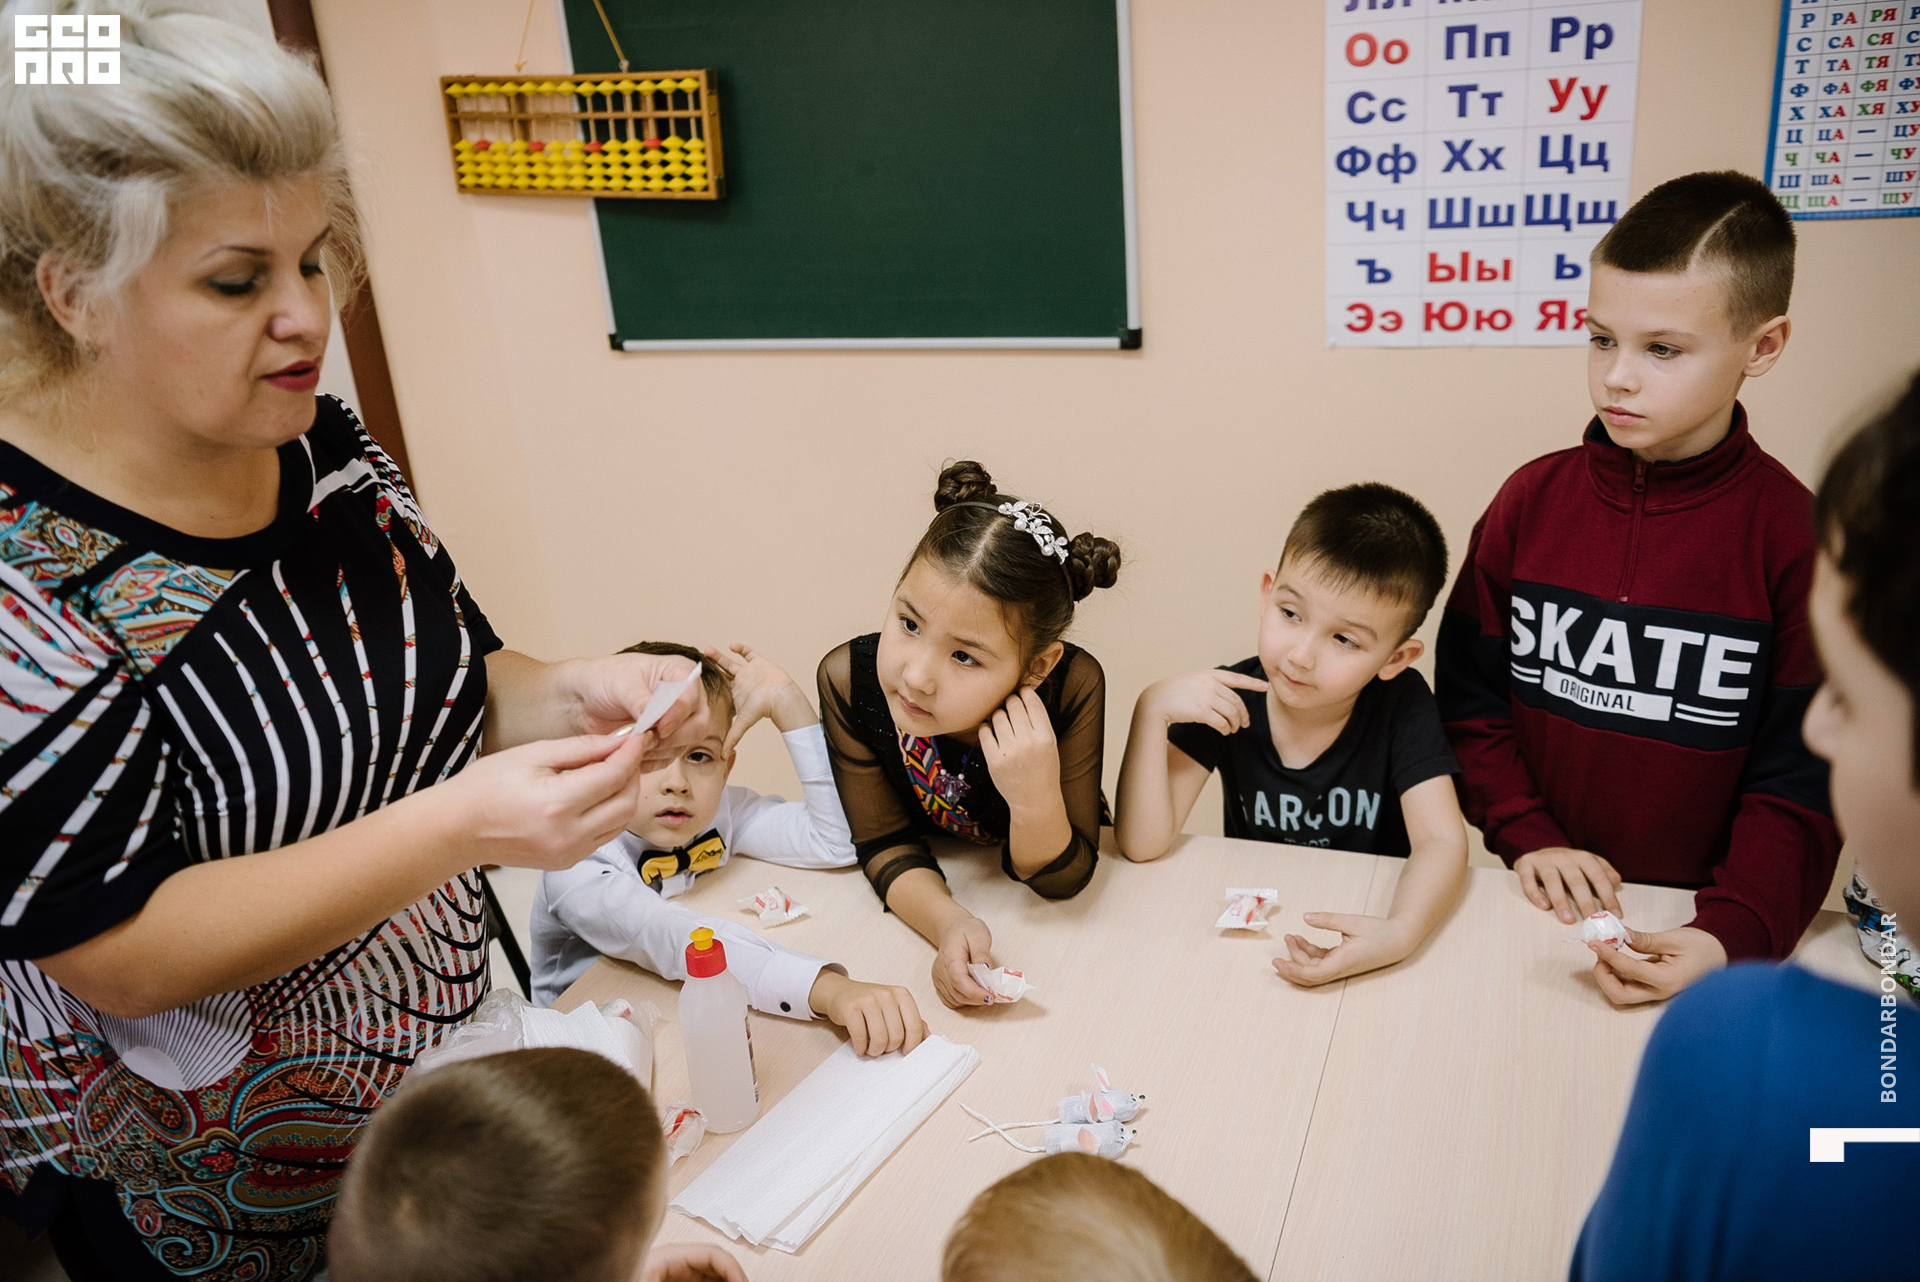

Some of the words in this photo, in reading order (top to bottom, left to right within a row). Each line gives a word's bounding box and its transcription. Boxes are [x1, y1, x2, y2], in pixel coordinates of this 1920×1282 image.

[1801, 13, 1816, 28] Р
[1831, 12, 1858, 26] РА
[1870, 8, 1898, 22] РЯ
[1345, 32, 1409, 67] Оо
[1445, 24, 1510, 60] Пп
[1550, 16, 1614, 60] Рр
[1797, 37, 1812, 52] С
[1828, 35, 1855, 49] СА
[1867, 32, 1894, 46] СЯ
[1907, 31, 1920, 43] С
[1795, 59, 1810, 74] Т
[1826, 59, 1851, 72] ТА
[1865, 55, 1890, 69] ТЯ
[1347, 91, 1406, 124] Сс
[1448, 83, 1503, 118] Тт
[1549, 77, 1608, 120] Уу
[1790, 83, 1809, 98] Ф
[1823, 82, 1851, 95] ФА
[1860, 79, 1889, 92] ФЯ
[1789, 106, 1805, 121] Х
[1818, 105, 1846, 118] ХА
[1857, 102, 1885, 116] ХЯ
[1786, 129, 1803, 144] Ц
[1818, 128, 1845, 141] ЦА
[1894, 124, 1920, 137] ЦУ
[1335, 143, 1417, 183] Фф
[1442, 139, 1504, 172] Хх
[1539, 134, 1609, 174] Цц
[1785, 153, 1798, 166] Ч
[1816, 151, 1841, 164] ЧА
[1891, 147, 1917, 160] ЧУ
[1779, 174, 1801, 188] Ш
[1811, 174, 1842, 186] ША
[1885, 170, 1917, 183] ШУ
[1347, 201, 1405, 231] Чч
[1429, 197, 1515, 229] Шш
[1525, 193, 1617, 232] Щщ
[1429, 252, 1511, 282] Ыы
[1346, 302, 1403, 332] Ээ
[1425, 302, 1512, 331] Юю
[1511, 595, 1760, 700] SKATE
[1559, 678, 1636, 712] ORIGINAL
[1239, 787, 1381, 831] ARÇON
